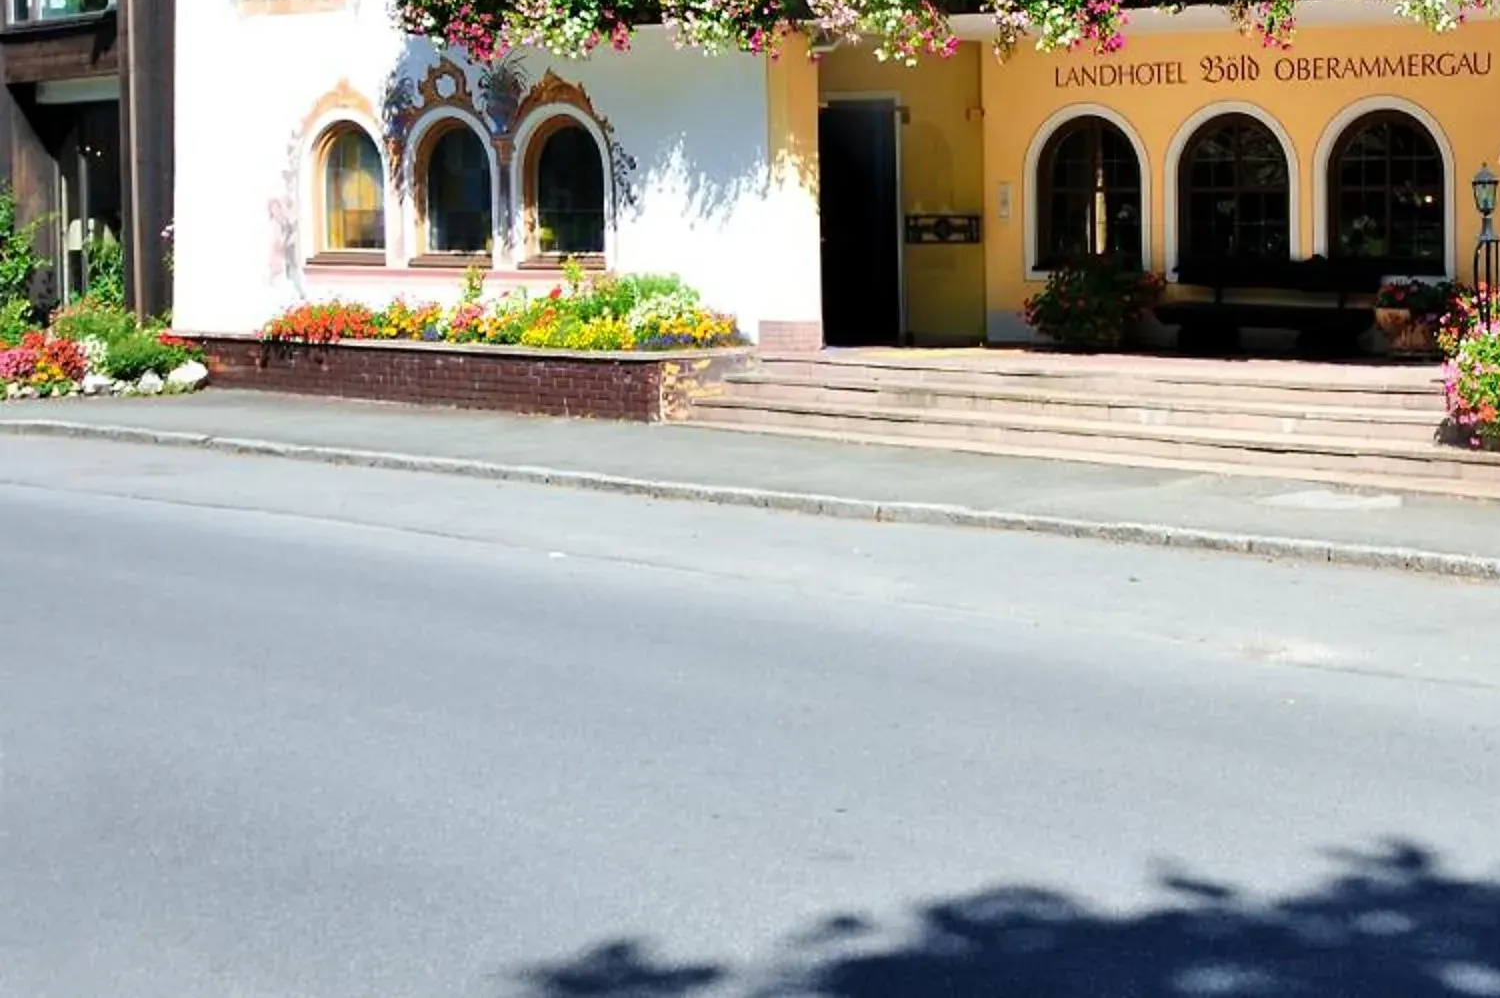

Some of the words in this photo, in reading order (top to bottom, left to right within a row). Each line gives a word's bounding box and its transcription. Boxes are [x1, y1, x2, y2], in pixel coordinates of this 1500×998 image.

[1054, 60, 1187, 88] LANDHOTEL
[1199, 54, 1260, 83] Böld
[1273, 52, 1492, 82] OBERAMMERGAU
